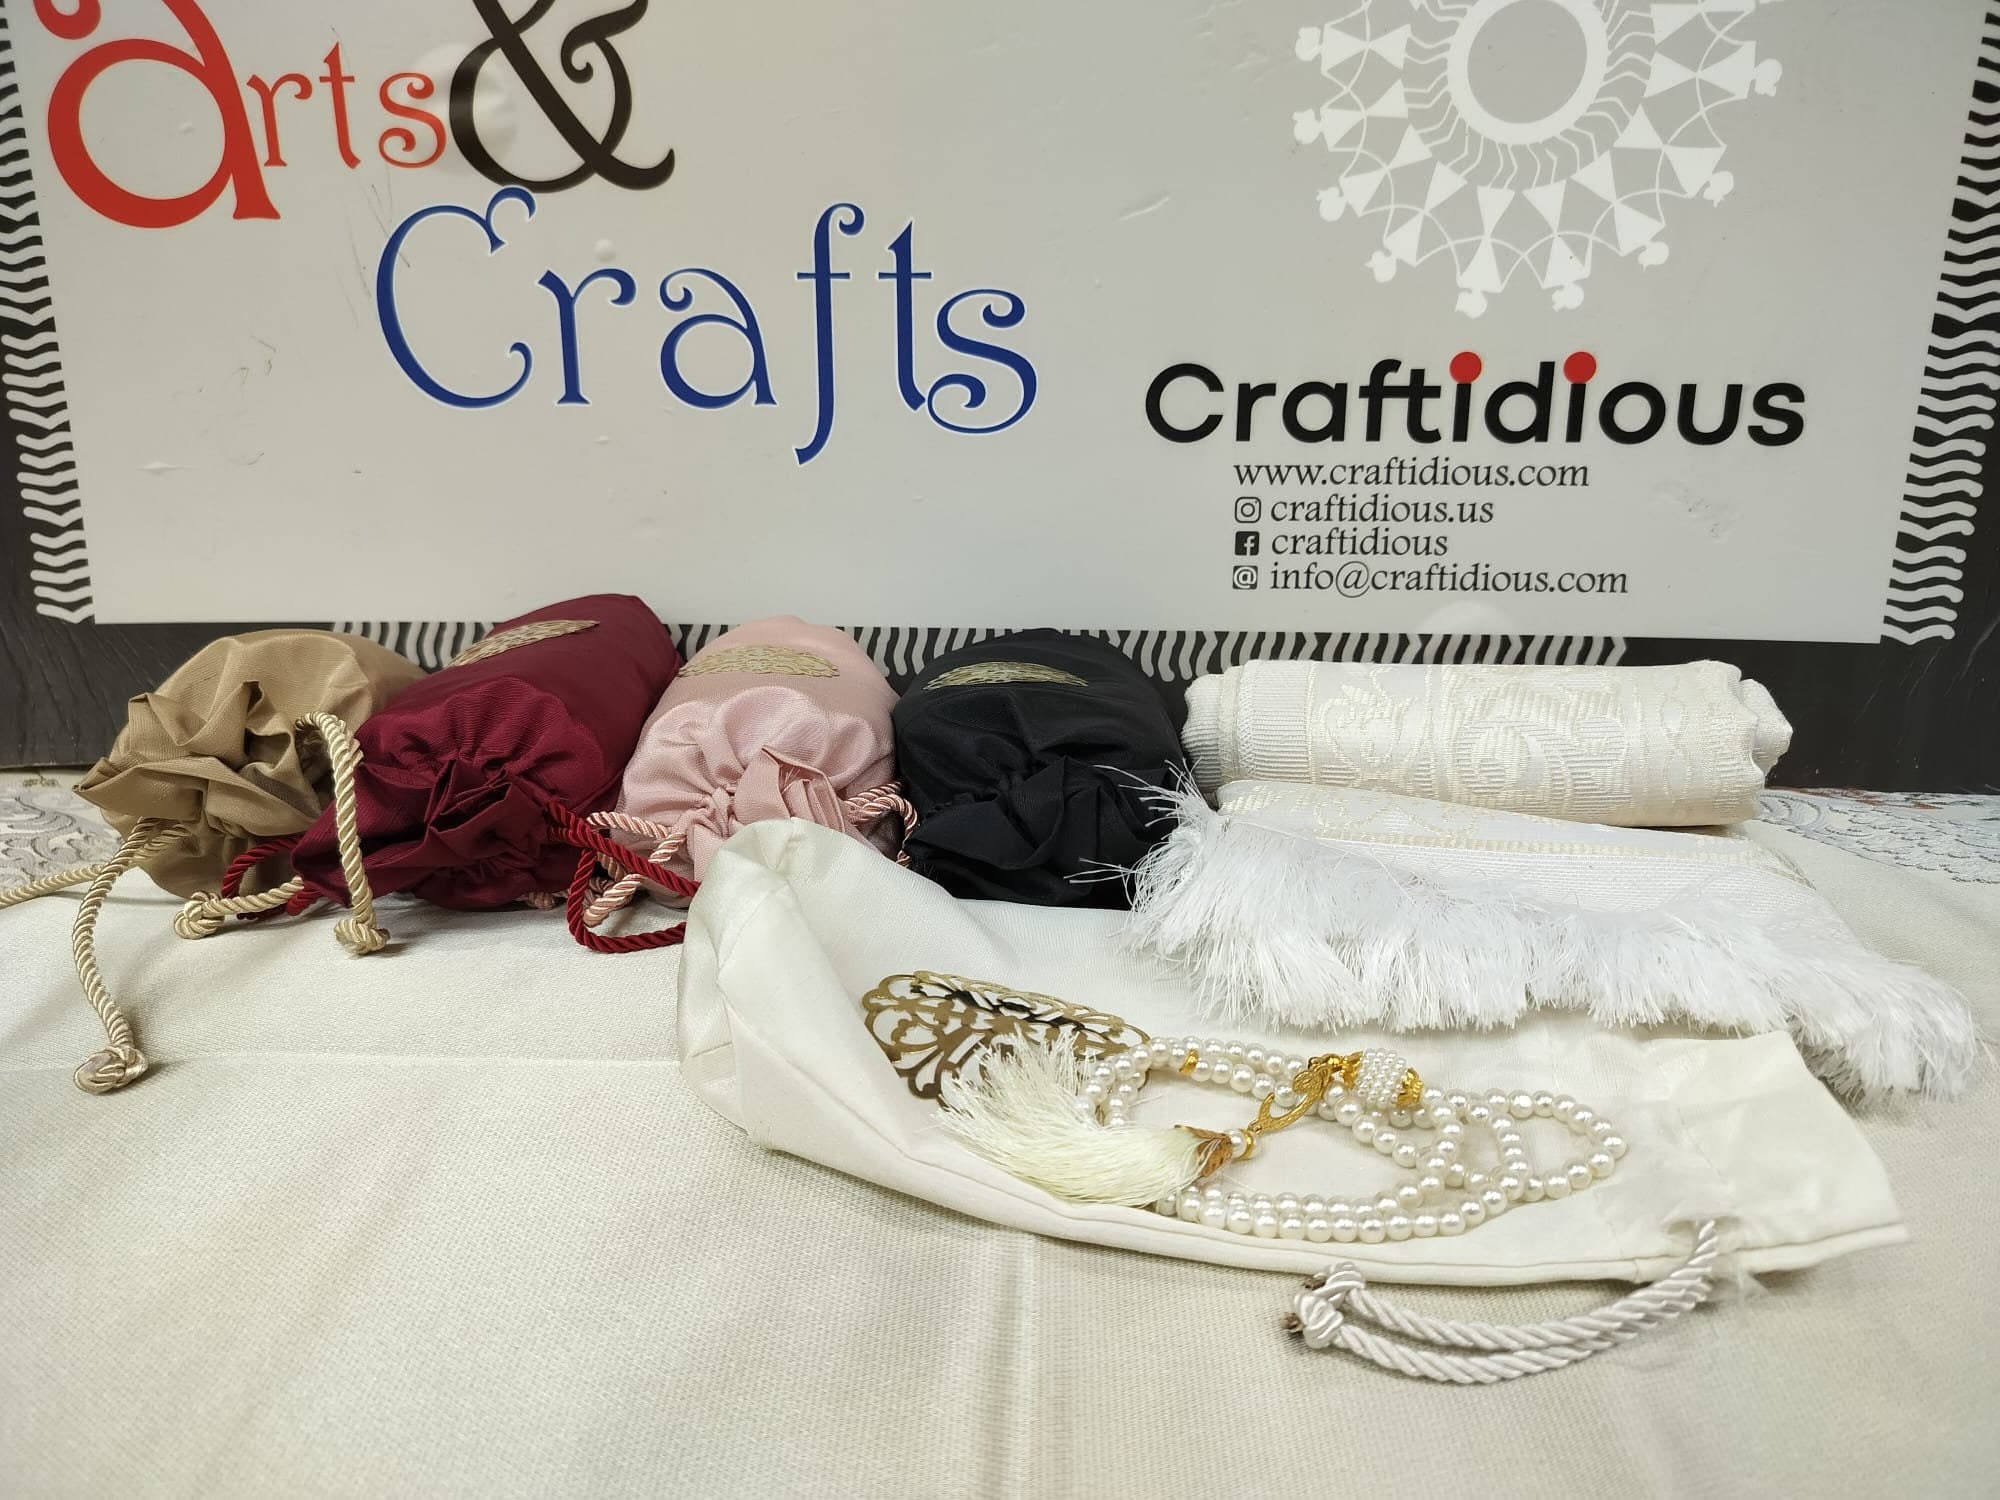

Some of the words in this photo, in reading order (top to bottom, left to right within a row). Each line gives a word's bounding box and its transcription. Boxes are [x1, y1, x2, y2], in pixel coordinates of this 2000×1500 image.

[376, 186, 1037, 465] Crafts
[1145, 351, 1807, 447] Craftidious
[1233, 456, 1590, 487] www.craftidious.com
[1270, 493, 1495, 523] craftidious.us
[1271, 526, 1449, 556] craftidious
[1270, 561, 1628, 599] info@craftidious.com
